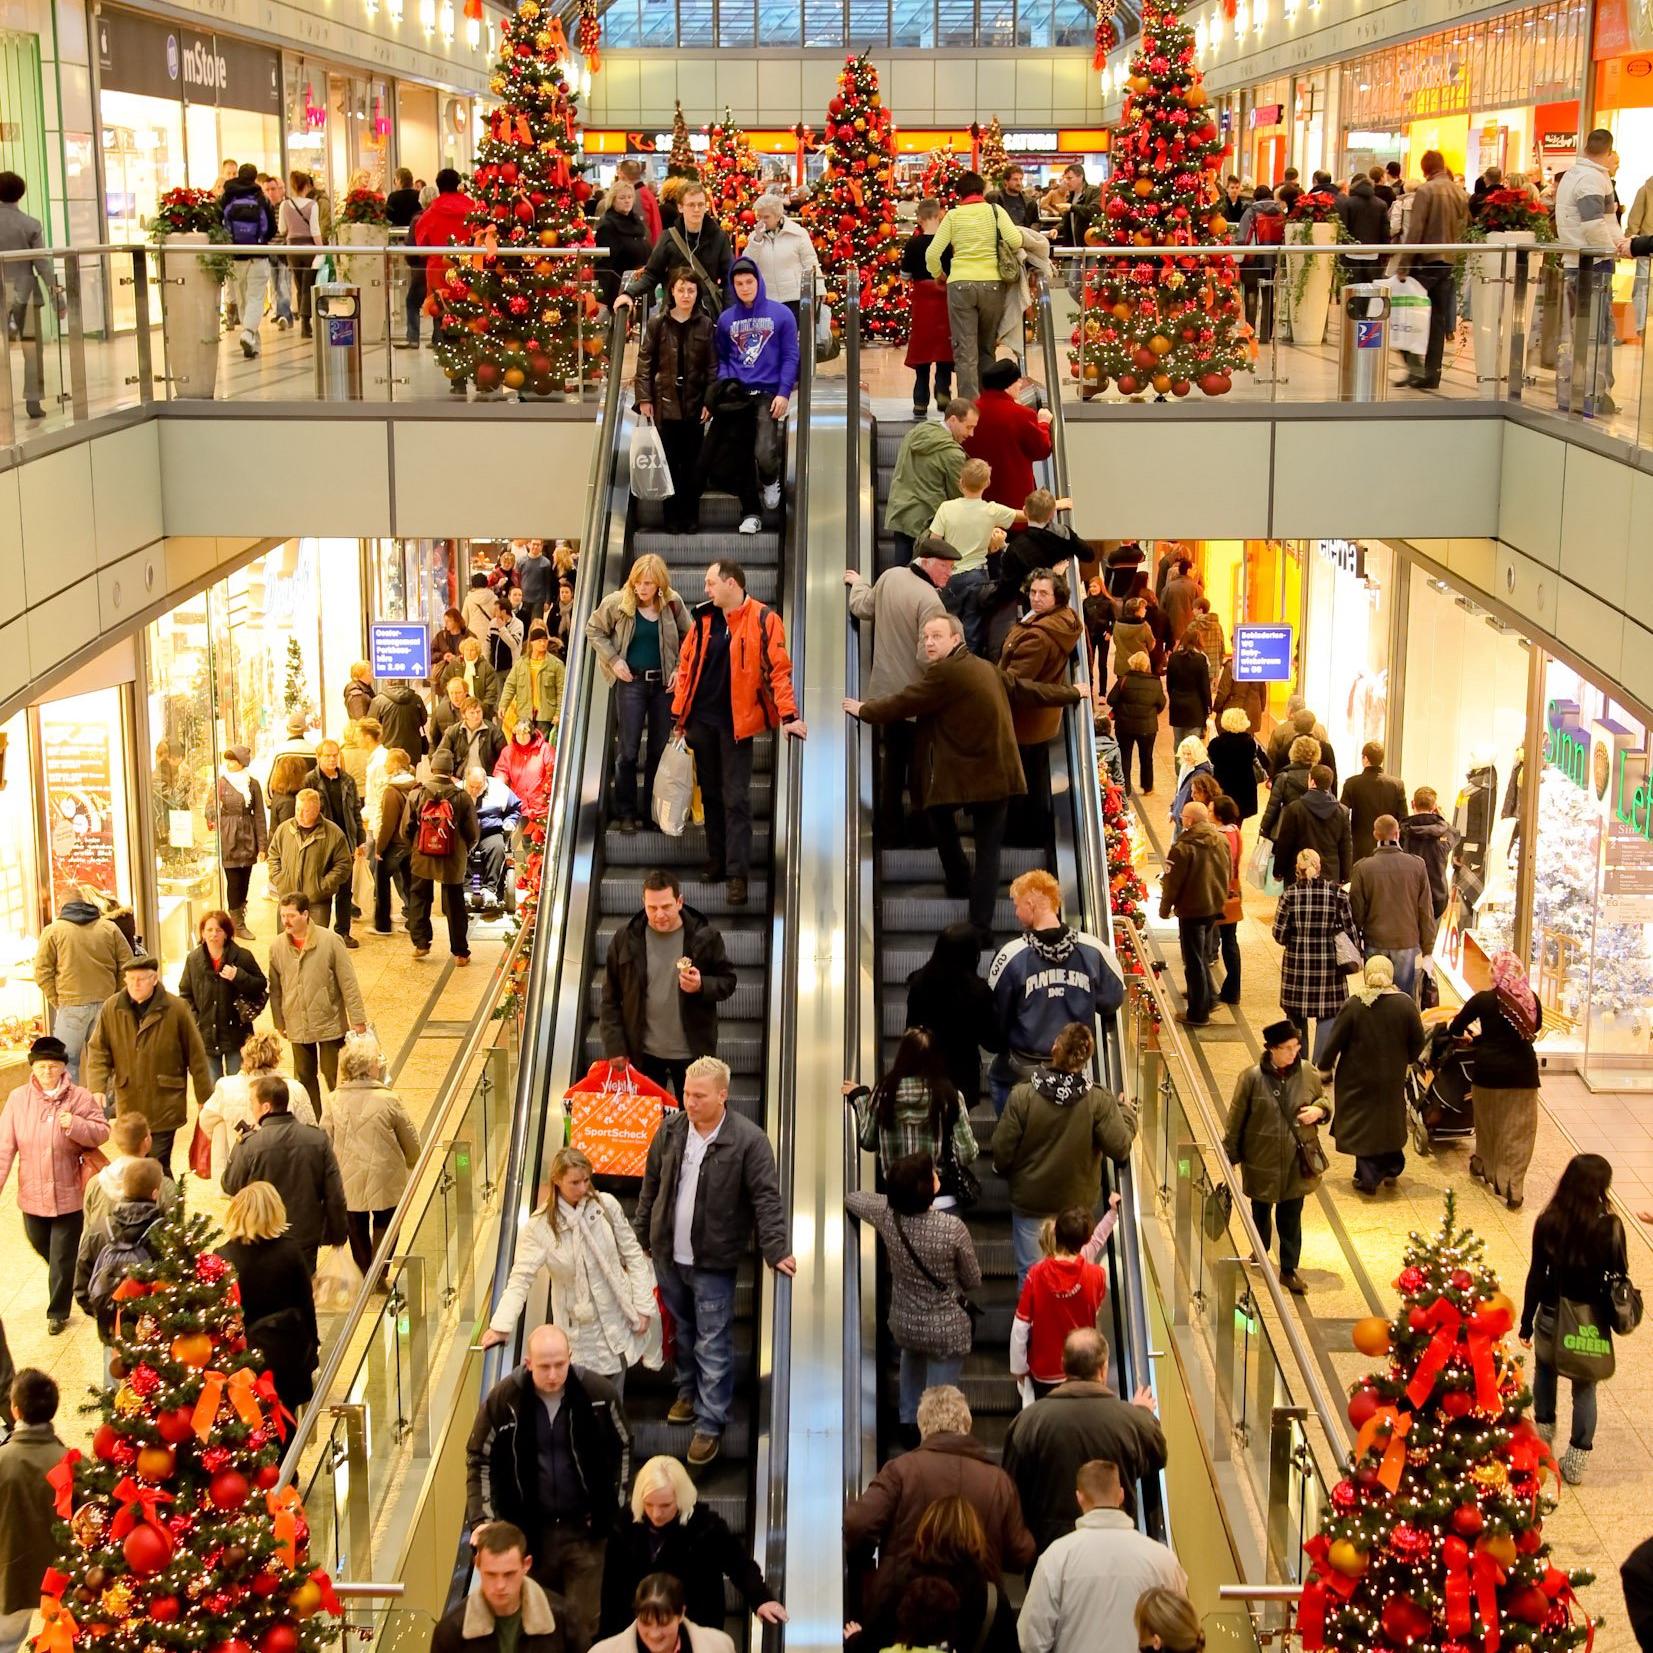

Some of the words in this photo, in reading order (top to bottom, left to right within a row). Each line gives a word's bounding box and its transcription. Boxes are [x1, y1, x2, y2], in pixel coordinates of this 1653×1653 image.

[183, 40, 227, 89] mStore
[1544, 699, 1586, 790] Sinn
[584, 1126, 648, 1140] SportScheck
[1563, 1334, 1611, 1355] GREEN
